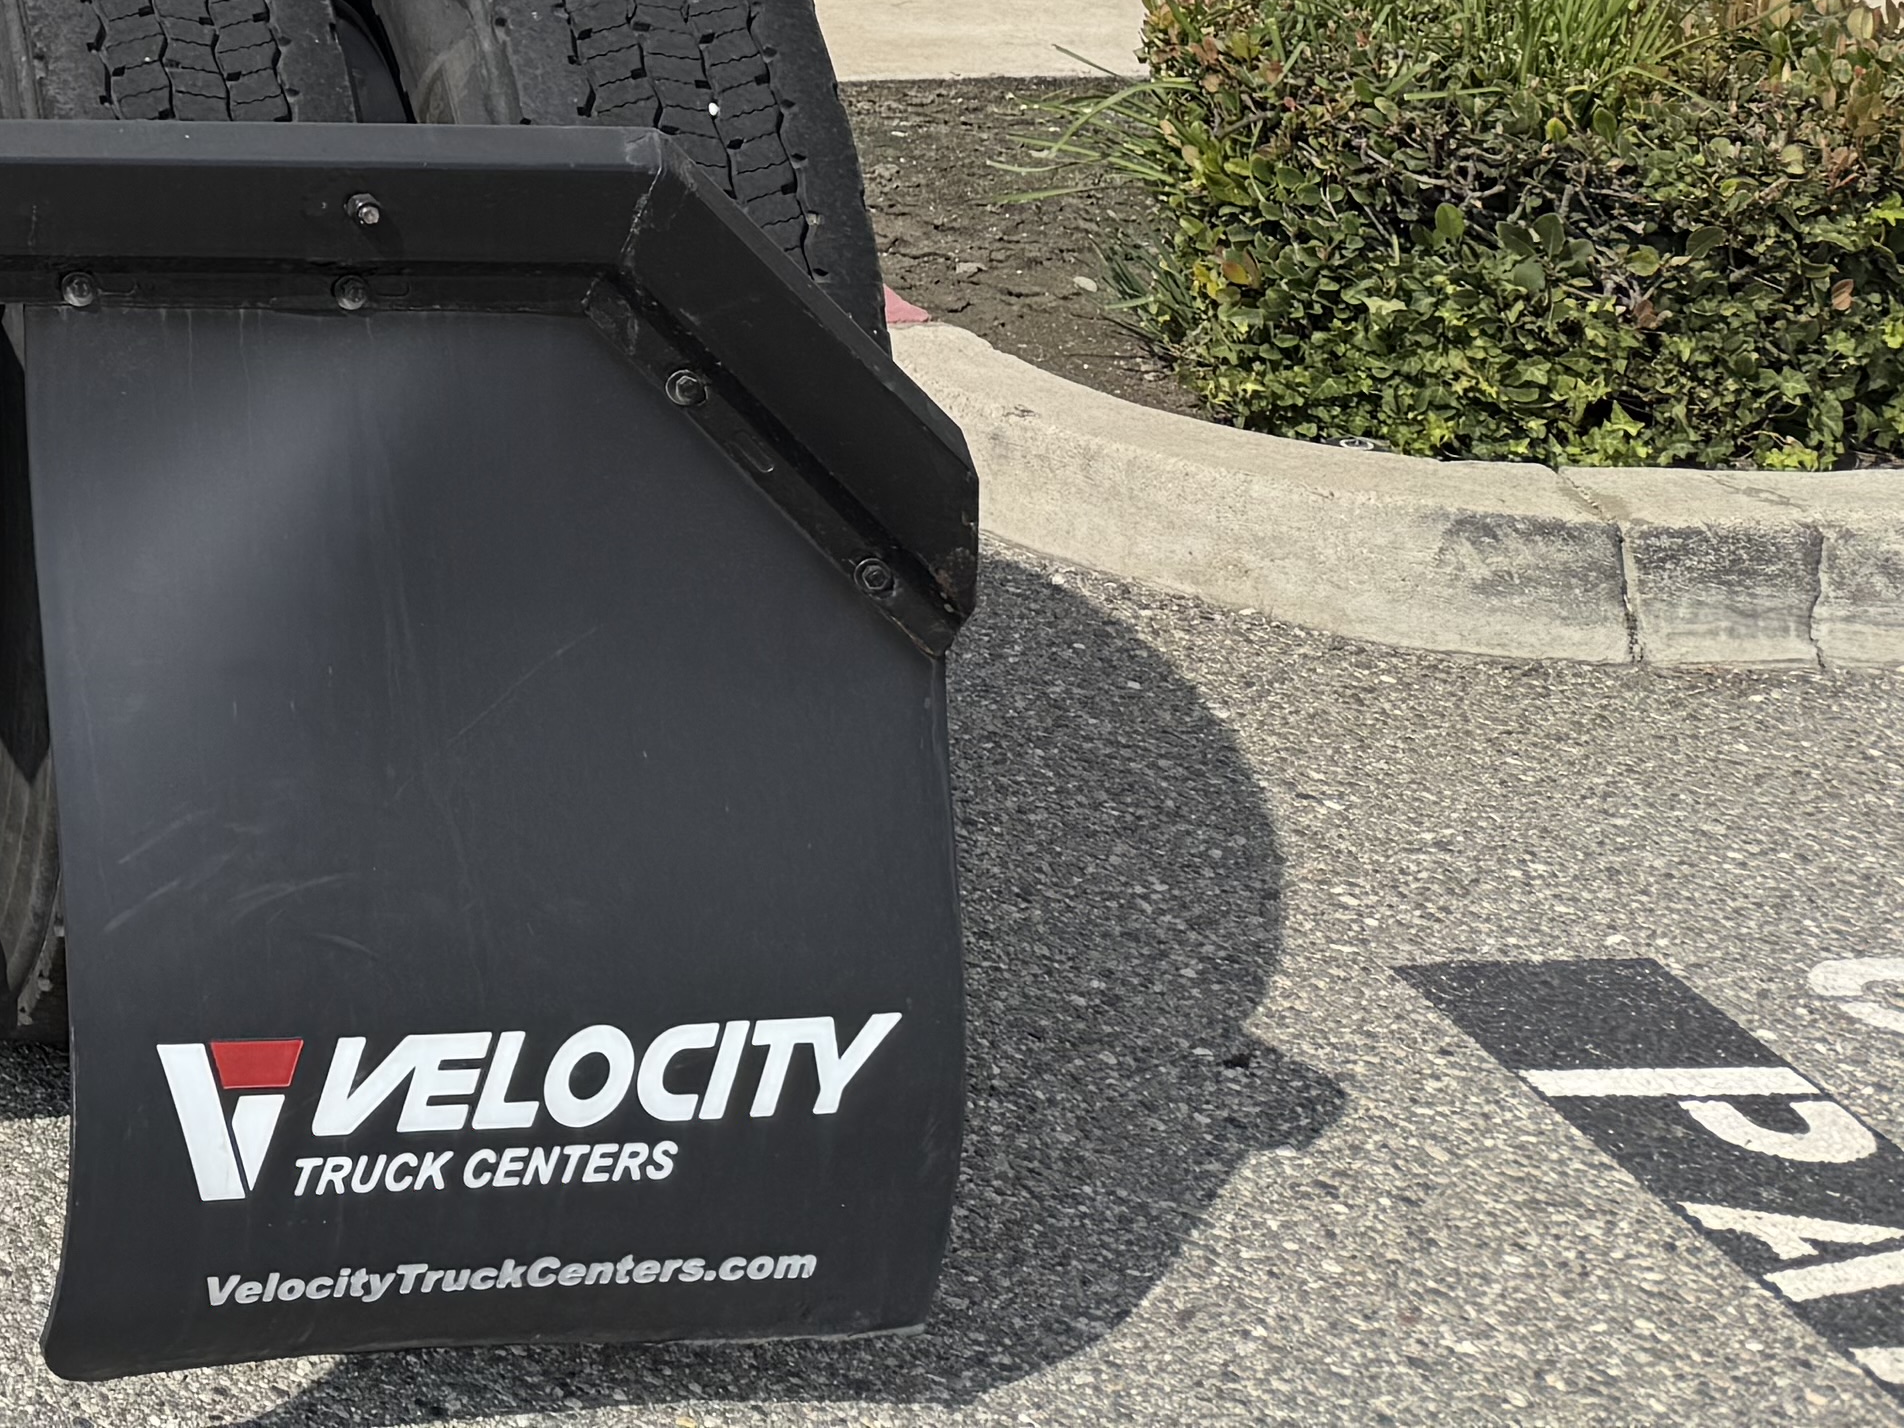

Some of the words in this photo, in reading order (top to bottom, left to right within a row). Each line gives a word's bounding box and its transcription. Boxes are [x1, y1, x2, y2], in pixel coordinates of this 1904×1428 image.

[311, 1012, 903, 1137] VELOCITY
[294, 1150, 455, 1197] TRUCK
[463, 1140, 679, 1189] CENTERS
[206, 1253, 818, 1307] VelocityTruckCenters.com
